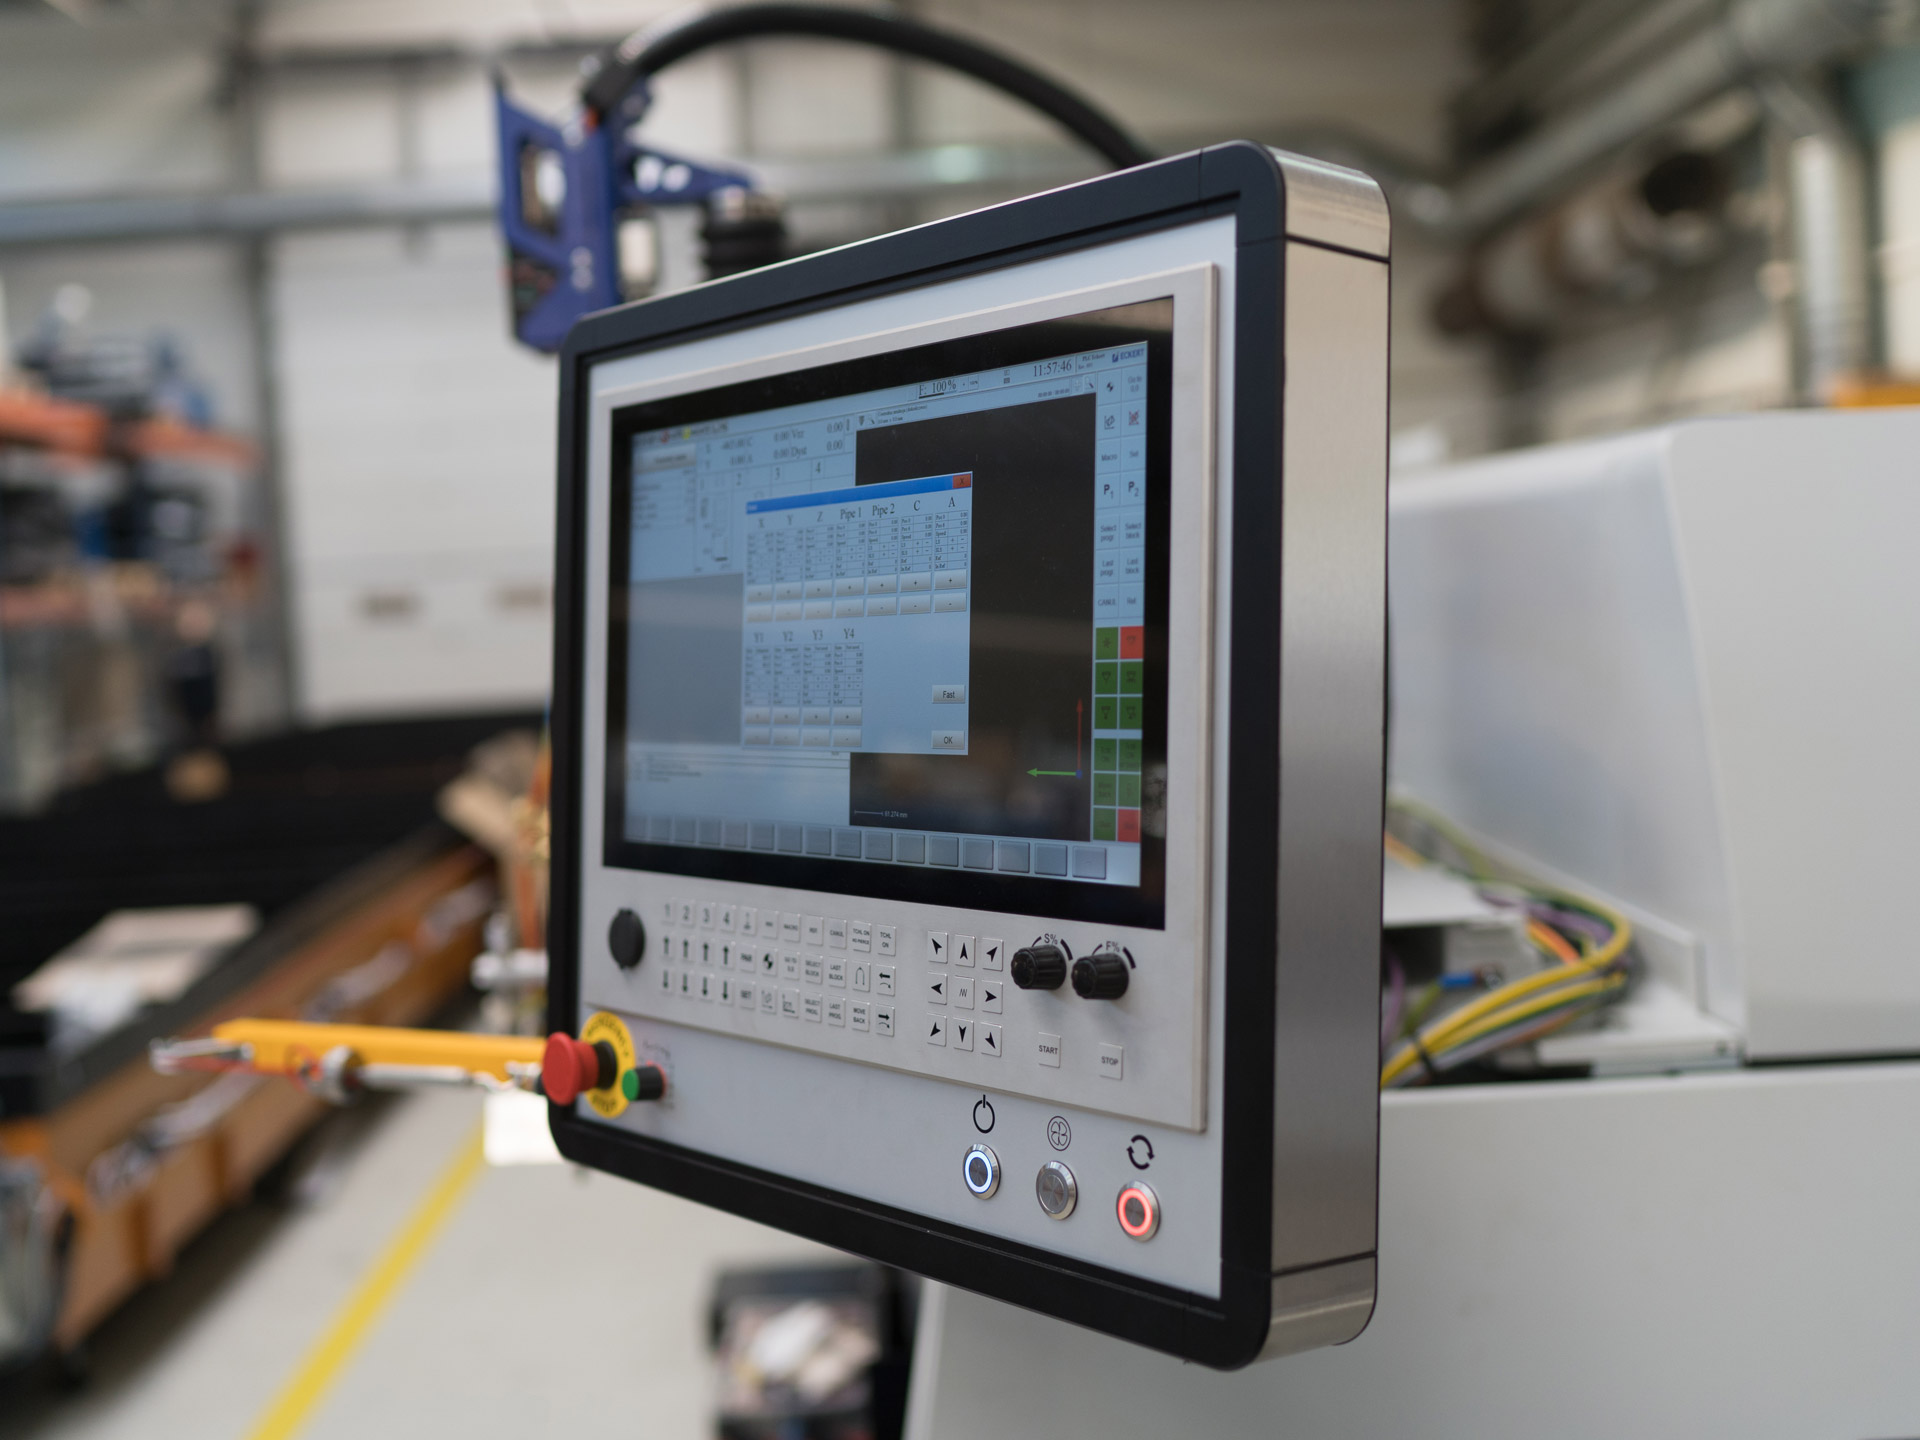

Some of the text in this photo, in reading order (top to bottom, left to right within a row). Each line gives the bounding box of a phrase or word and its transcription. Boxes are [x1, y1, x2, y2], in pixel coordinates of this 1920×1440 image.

[1120, 348, 1145, 361] ECKERT
[1033, 359, 1072, 378] 11:57:46
[932, 379, 957, 394] 100%
[1101, 453, 1118, 462] Macro
[913, 500, 921, 512] C
[948, 496, 956, 508] A
[840, 508, 856, 521] Pipe
[872, 502, 896, 518] Pipe 2
[843, 628, 855, 639] Y4
[942, 690, 956, 699] Fast
[943, 736, 954, 745] OK
[683, 905, 690, 921] 2
[703, 907, 711, 923] 3
[723, 911, 731, 926] 4
[882, 941, 890, 949] ON
[1044, 932, 1058, 946] S%
[1105, 940, 1120, 953] F%
[805, 969, 820, 978] BLOCK
[830, 964, 842, 972] LAST
[829, 973, 844, 982] BLOCK
[829, 1002, 841, 1011] LAST
[853, 1007, 866, 1016] MOVE
[853, 1016, 866, 1025] BACK
[1038, 1044, 1058, 1056] START
[1101, 1055, 1119, 1067] STOP
